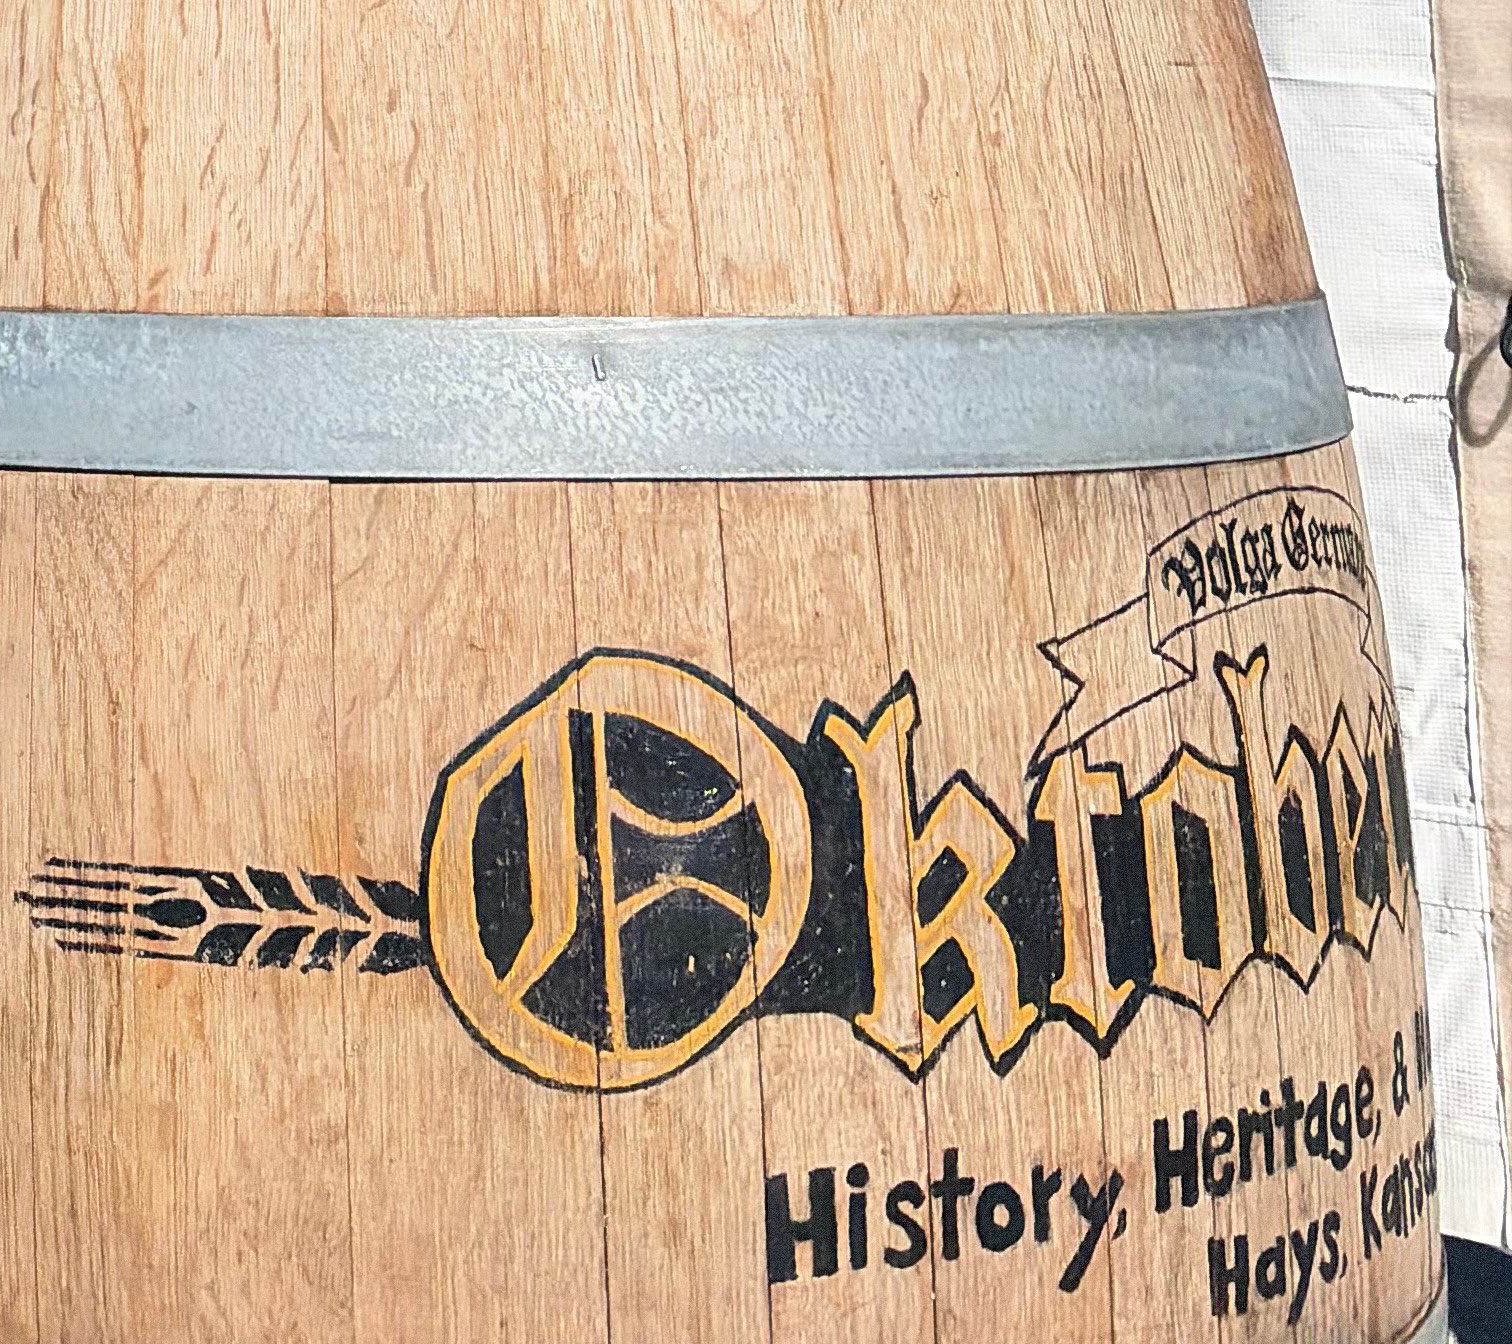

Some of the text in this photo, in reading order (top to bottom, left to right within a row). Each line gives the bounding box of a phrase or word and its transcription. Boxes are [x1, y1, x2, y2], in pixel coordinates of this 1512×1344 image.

[1161, 517, 1282, 616] Volga
[765, 1147, 1128, 1294] History,
[1153, 1064, 1382, 1214] Heritage,
[1391, 1030, 1411, 1116] &
[1207, 1118, 1438, 1326] Hays, Kansa
